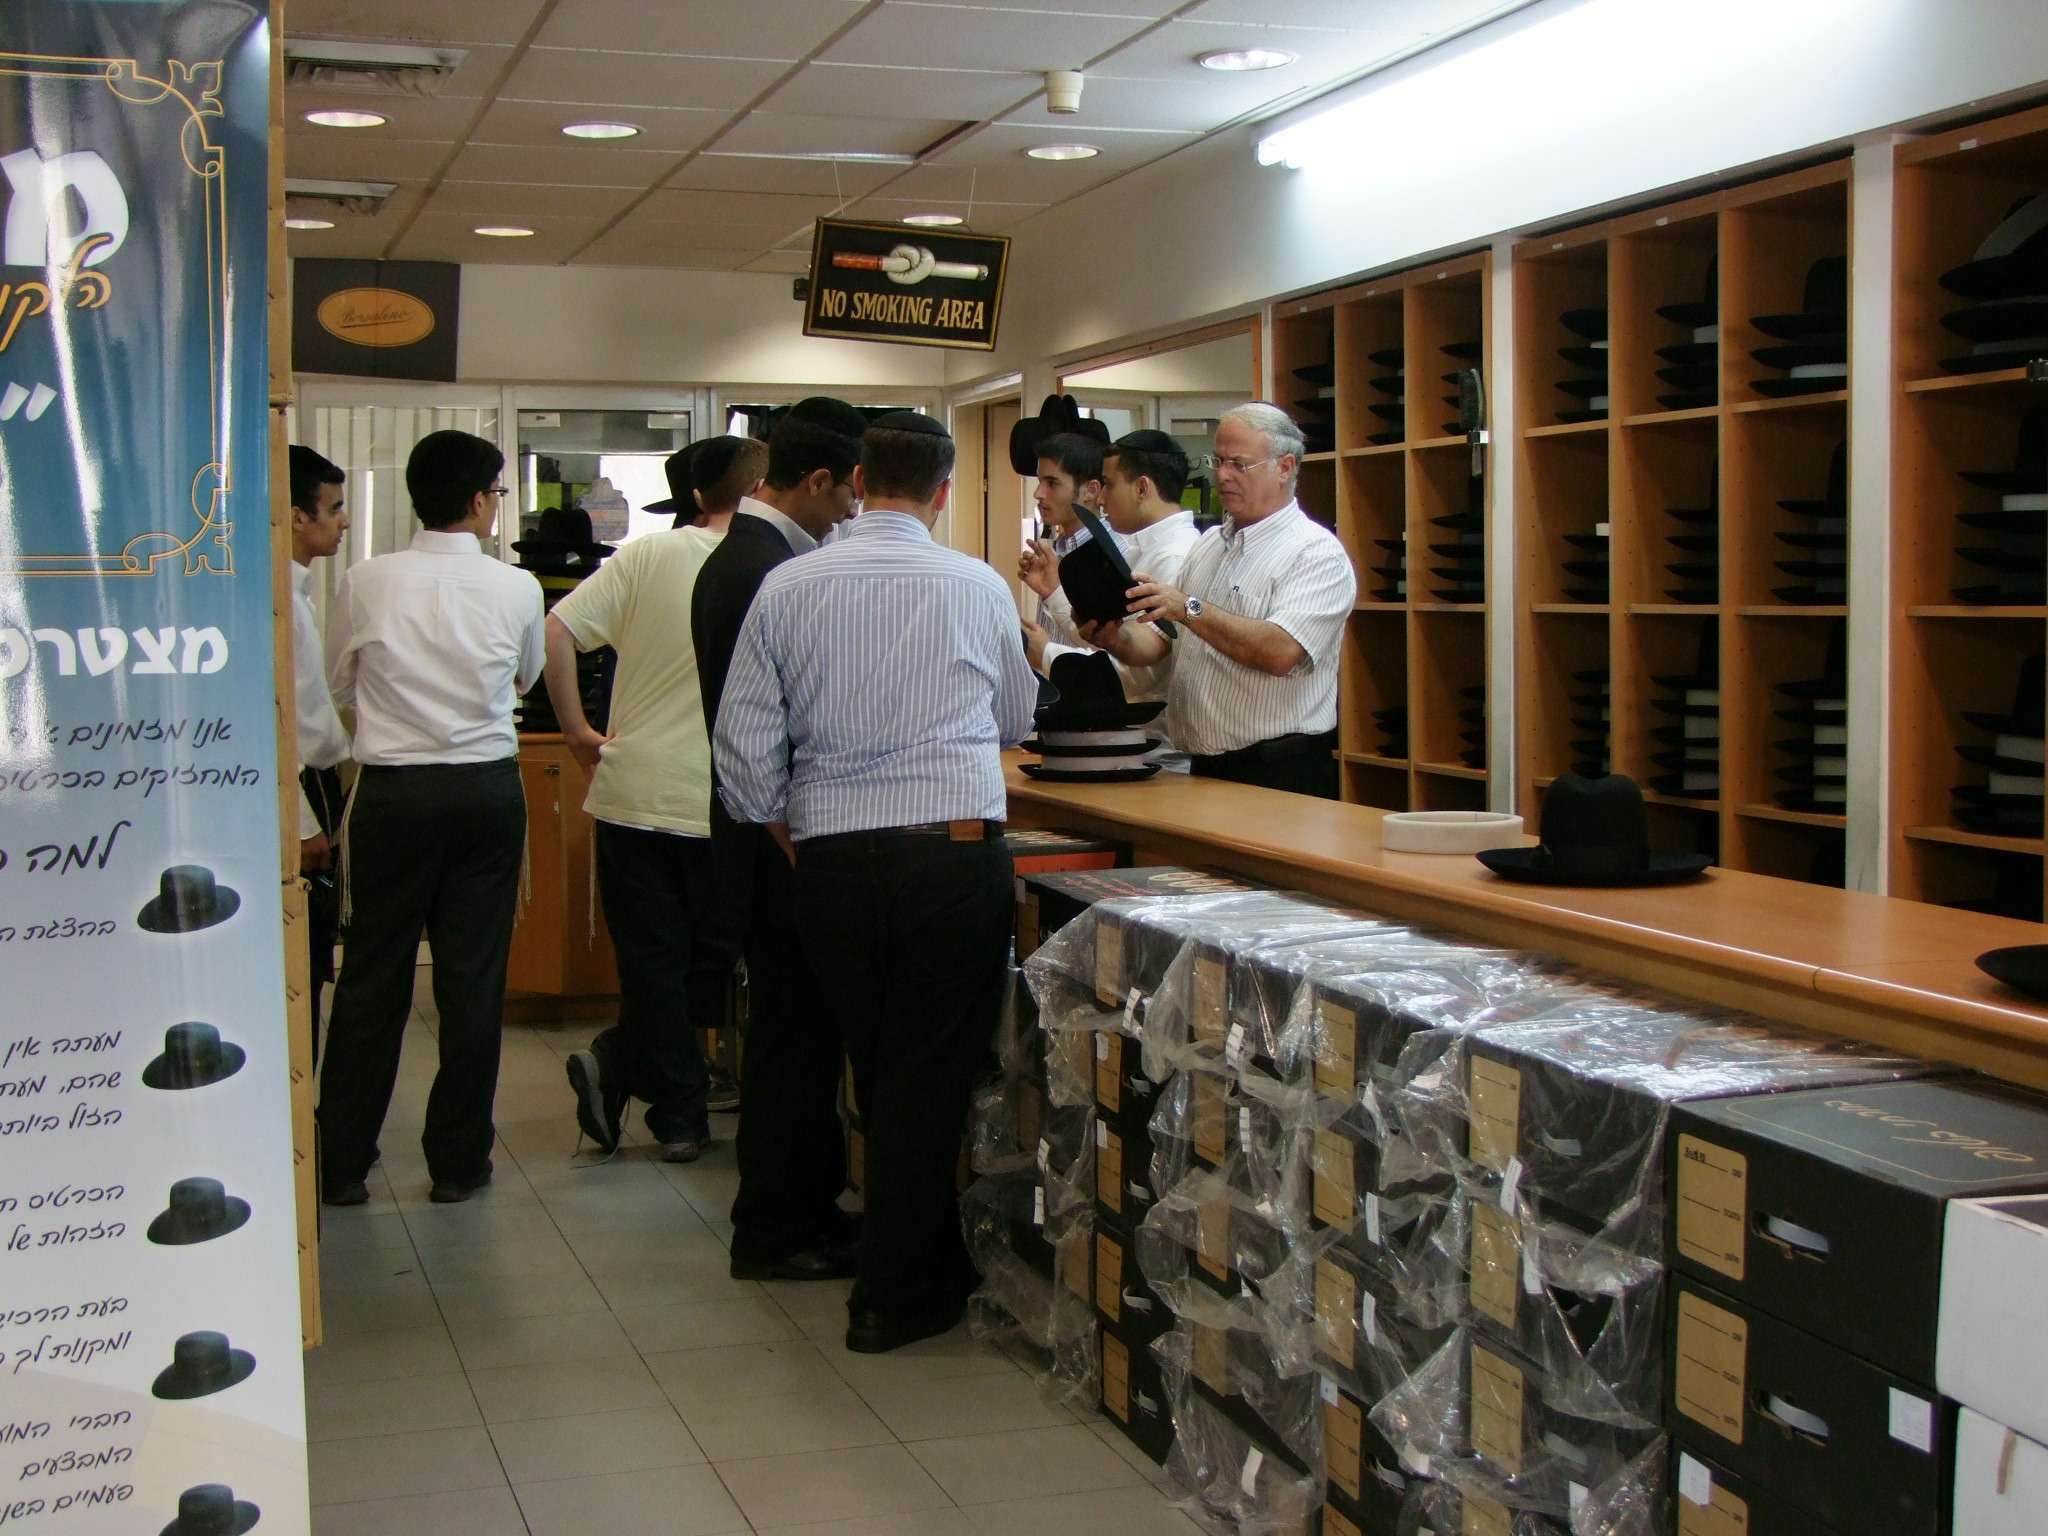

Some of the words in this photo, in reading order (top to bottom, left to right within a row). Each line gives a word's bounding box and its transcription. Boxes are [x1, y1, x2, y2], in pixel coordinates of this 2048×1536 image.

[820, 289, 847, 318] NO
[850, 291, 933, 326] SMOKING
[934, 297, 985, 331] AREA
[67, 717, 187, 750] מזמינים
[192, 717, 232, 749] אנו
[113, 763, 260, 798] המחזיקים
[26, 820, 132, 876] למה
[23, 917, 117, 941] בהצגת
[2, 1036, 41, 1069] אין
[52, 1030, 122, 1055] מעתה
[0, 1113, 60, 1136] ביות
[69, 1102, 122, 1130] הזול
[28, 1184, 125, 1210] הכרטיס
[7, 1223, 31, 1251] של
[37, 1220, 126, 1247] הזהות
[76, 1296, 129, 1318] בעת
[13, 1334, 53, 1375] לך
[48, 1330, 132, 1365] ומקנות
[69, 1410, 132, 1431] חברי
[19, 1446, 133, 1481] המבצעים
[52, 1483, 134, 1514] פעמיים
